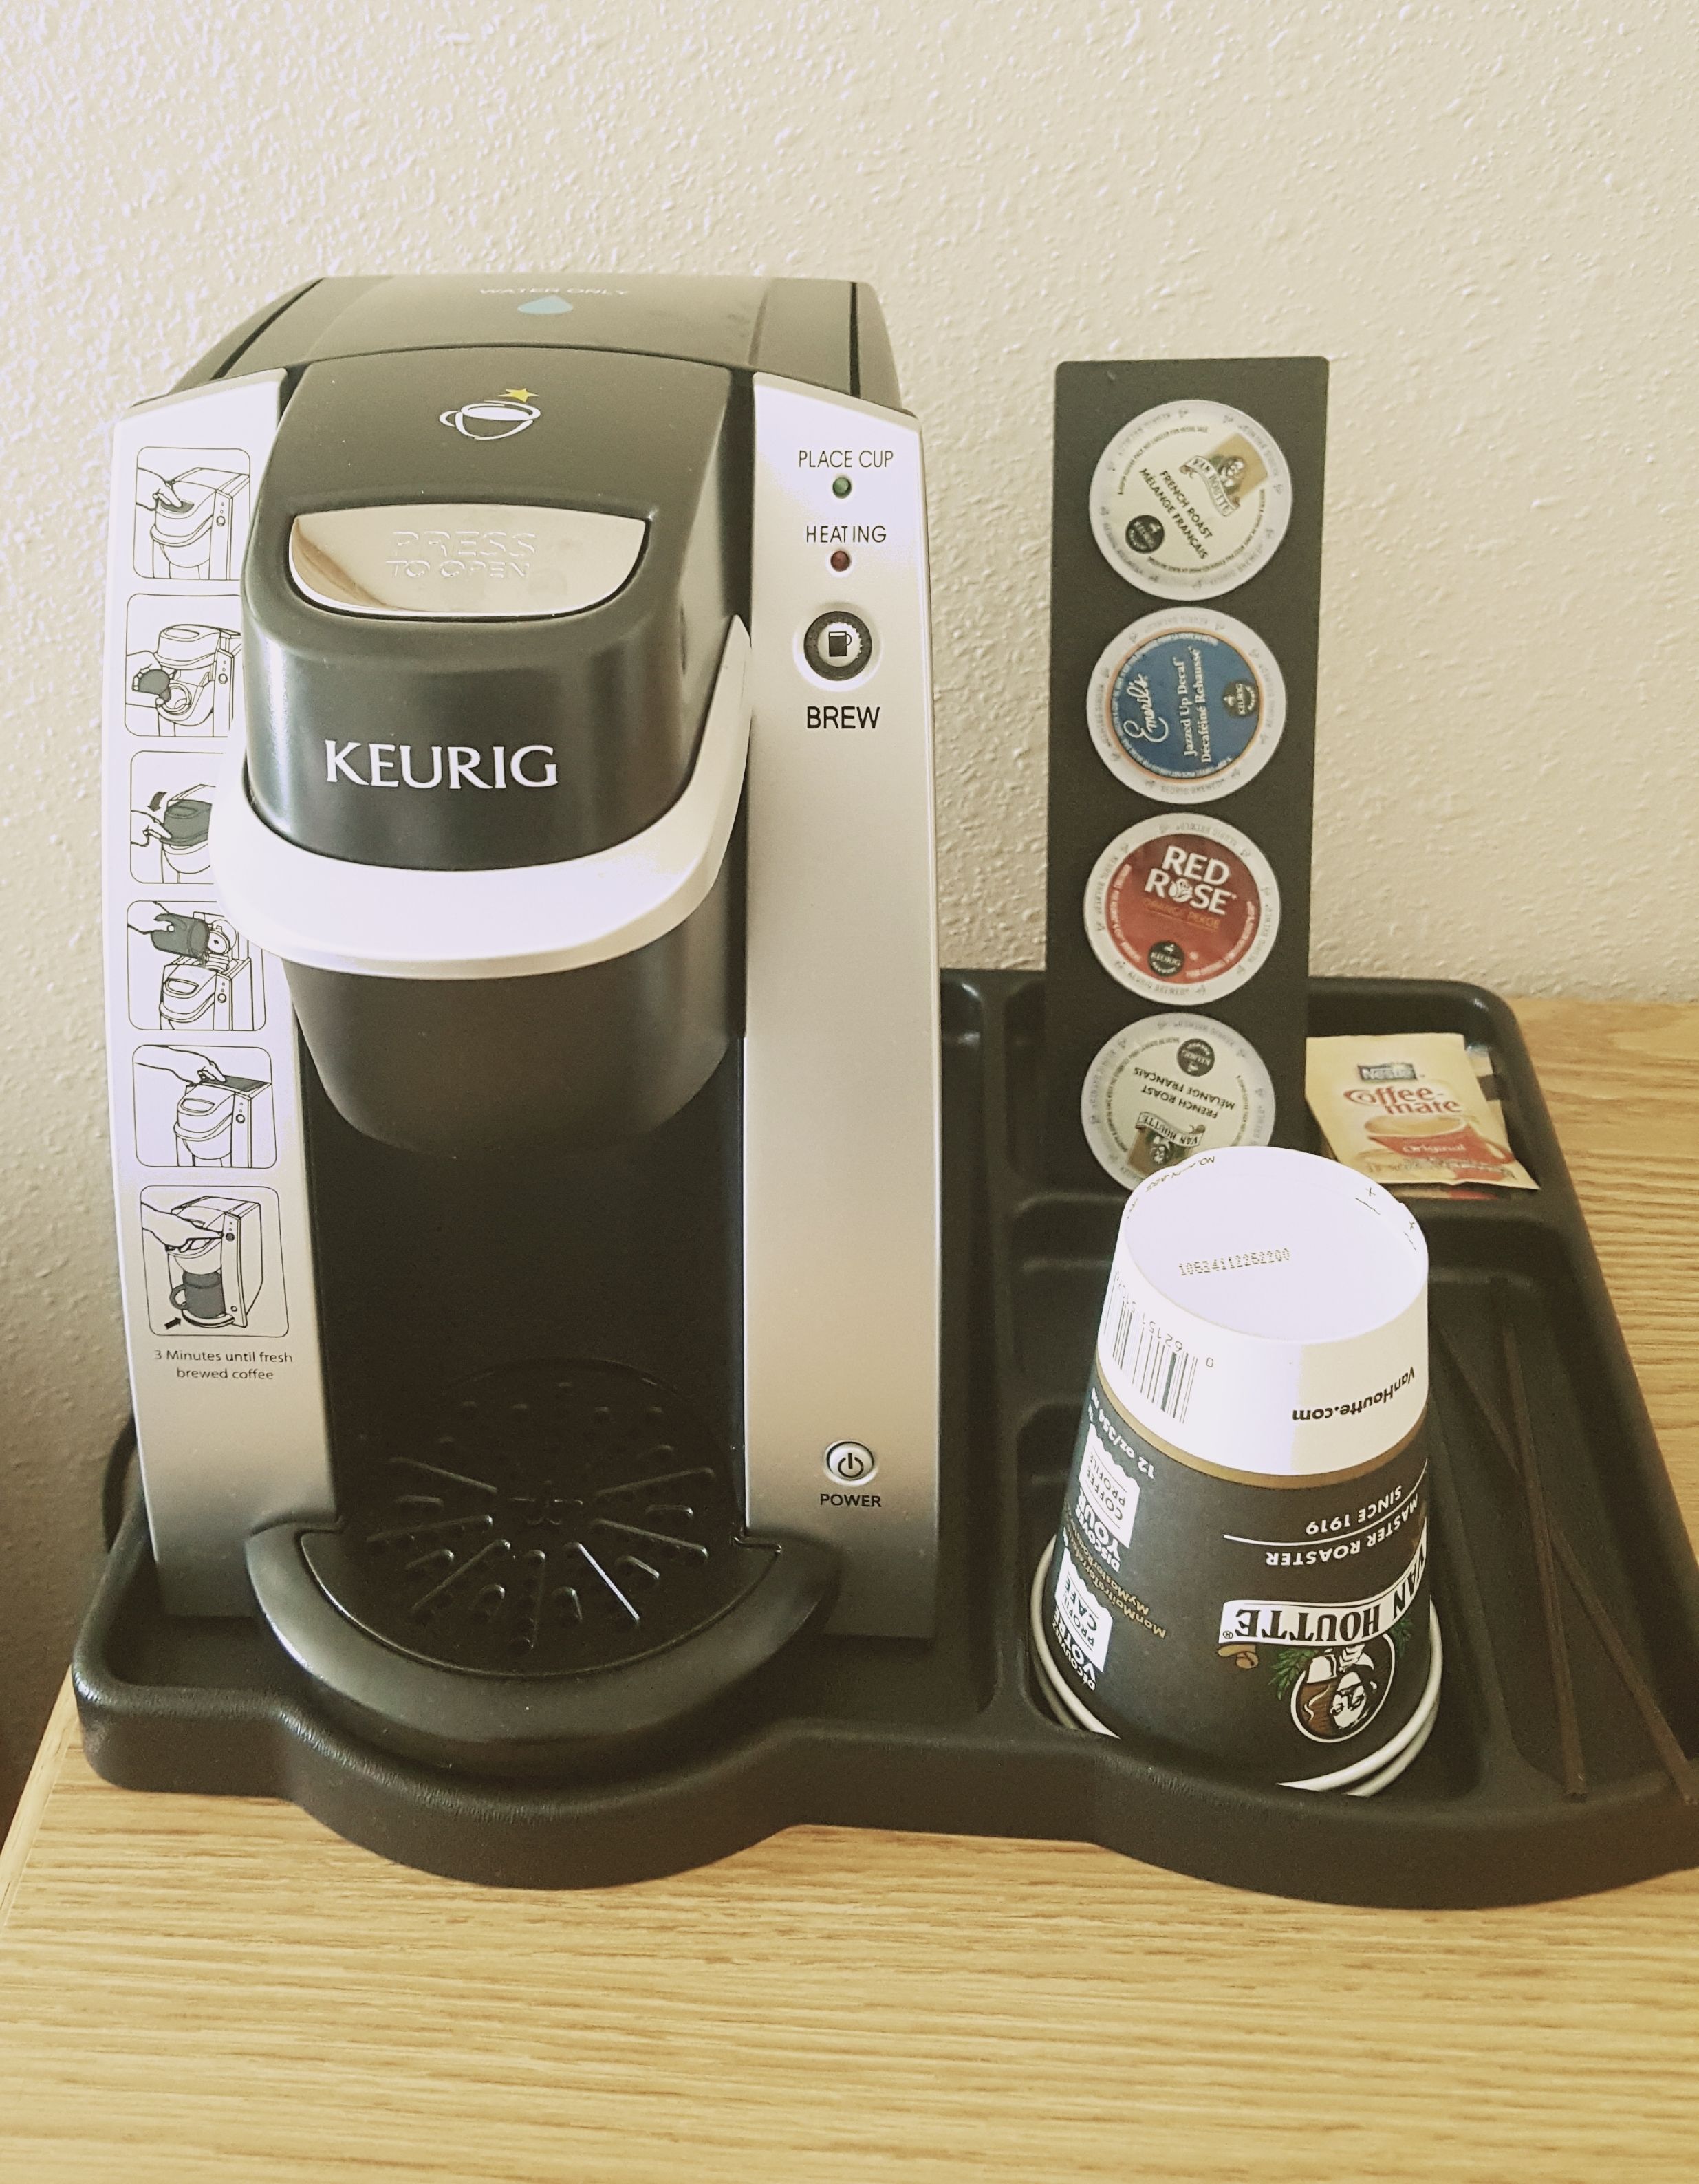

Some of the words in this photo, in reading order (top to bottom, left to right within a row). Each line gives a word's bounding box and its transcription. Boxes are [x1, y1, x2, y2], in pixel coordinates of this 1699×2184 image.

[799, 450, 853, 468] PLACE
[858, 450, 894, 468] CUP
[1159, 470, 1190, 508] FRENCH
[1186, 505, 1213, 539] ROAST
[392, 531, 536, 558] PRESS
[806, 525, 887, 543] HEATING
[385, 559, 431, 578] TO
[439, 559, 530, 579] OPEN
[806, 706, 880, 729] BREW
[1178, 697, 1193, 715] Up
[1180, 719, 1198, 757] Jazzed
[325, 739, 559, 790] KEURIG
[1161, 845, 1231, 886] RED
[1140, 1085, 1177, 1105] ROAST
[1384, 1099, 1462, 1115] mate
[1178, 1099, 1220, 1120] FRENCH
[1179, 1134, 1198, 1146] VAN
[1403, 1143, 1467, 1154] Original
[153, 1350, 162, 1360] 3
[166, 1350, 222, 1361] Minutes
[225, 1351, 256, 1362] until
[259, 1352, 294, 1363] fresh
[176, 1367, 228, 1379] brewed
[232, 1368, 274, 1380] coffee
[1292, 1366, 1415, 1422] VanHoutte.com
[1089, 1450, 1126, 1507] PROFILE
[1138, 1455, 1156, 1480] 12
[819, 1493, 882, 1508] POWER
[1087, 1467, 1124, 1522] COFFEE
[1356, 1484, 1403, 1524] SINCE
[1079, 1486, 1121, 1562] YOUR
[1305, 1513, 1352, 1535] 1919
[1367, 1493, 1419, 1548] MASTER
[1075, 1502, 1121, 1574] DISCOVER
[1266, 1539, 1361, 1566] ROASTER
[1392, 1539, 1427, 1620] VAN
[1053, 1605, 1096, 1683] VOTRE
